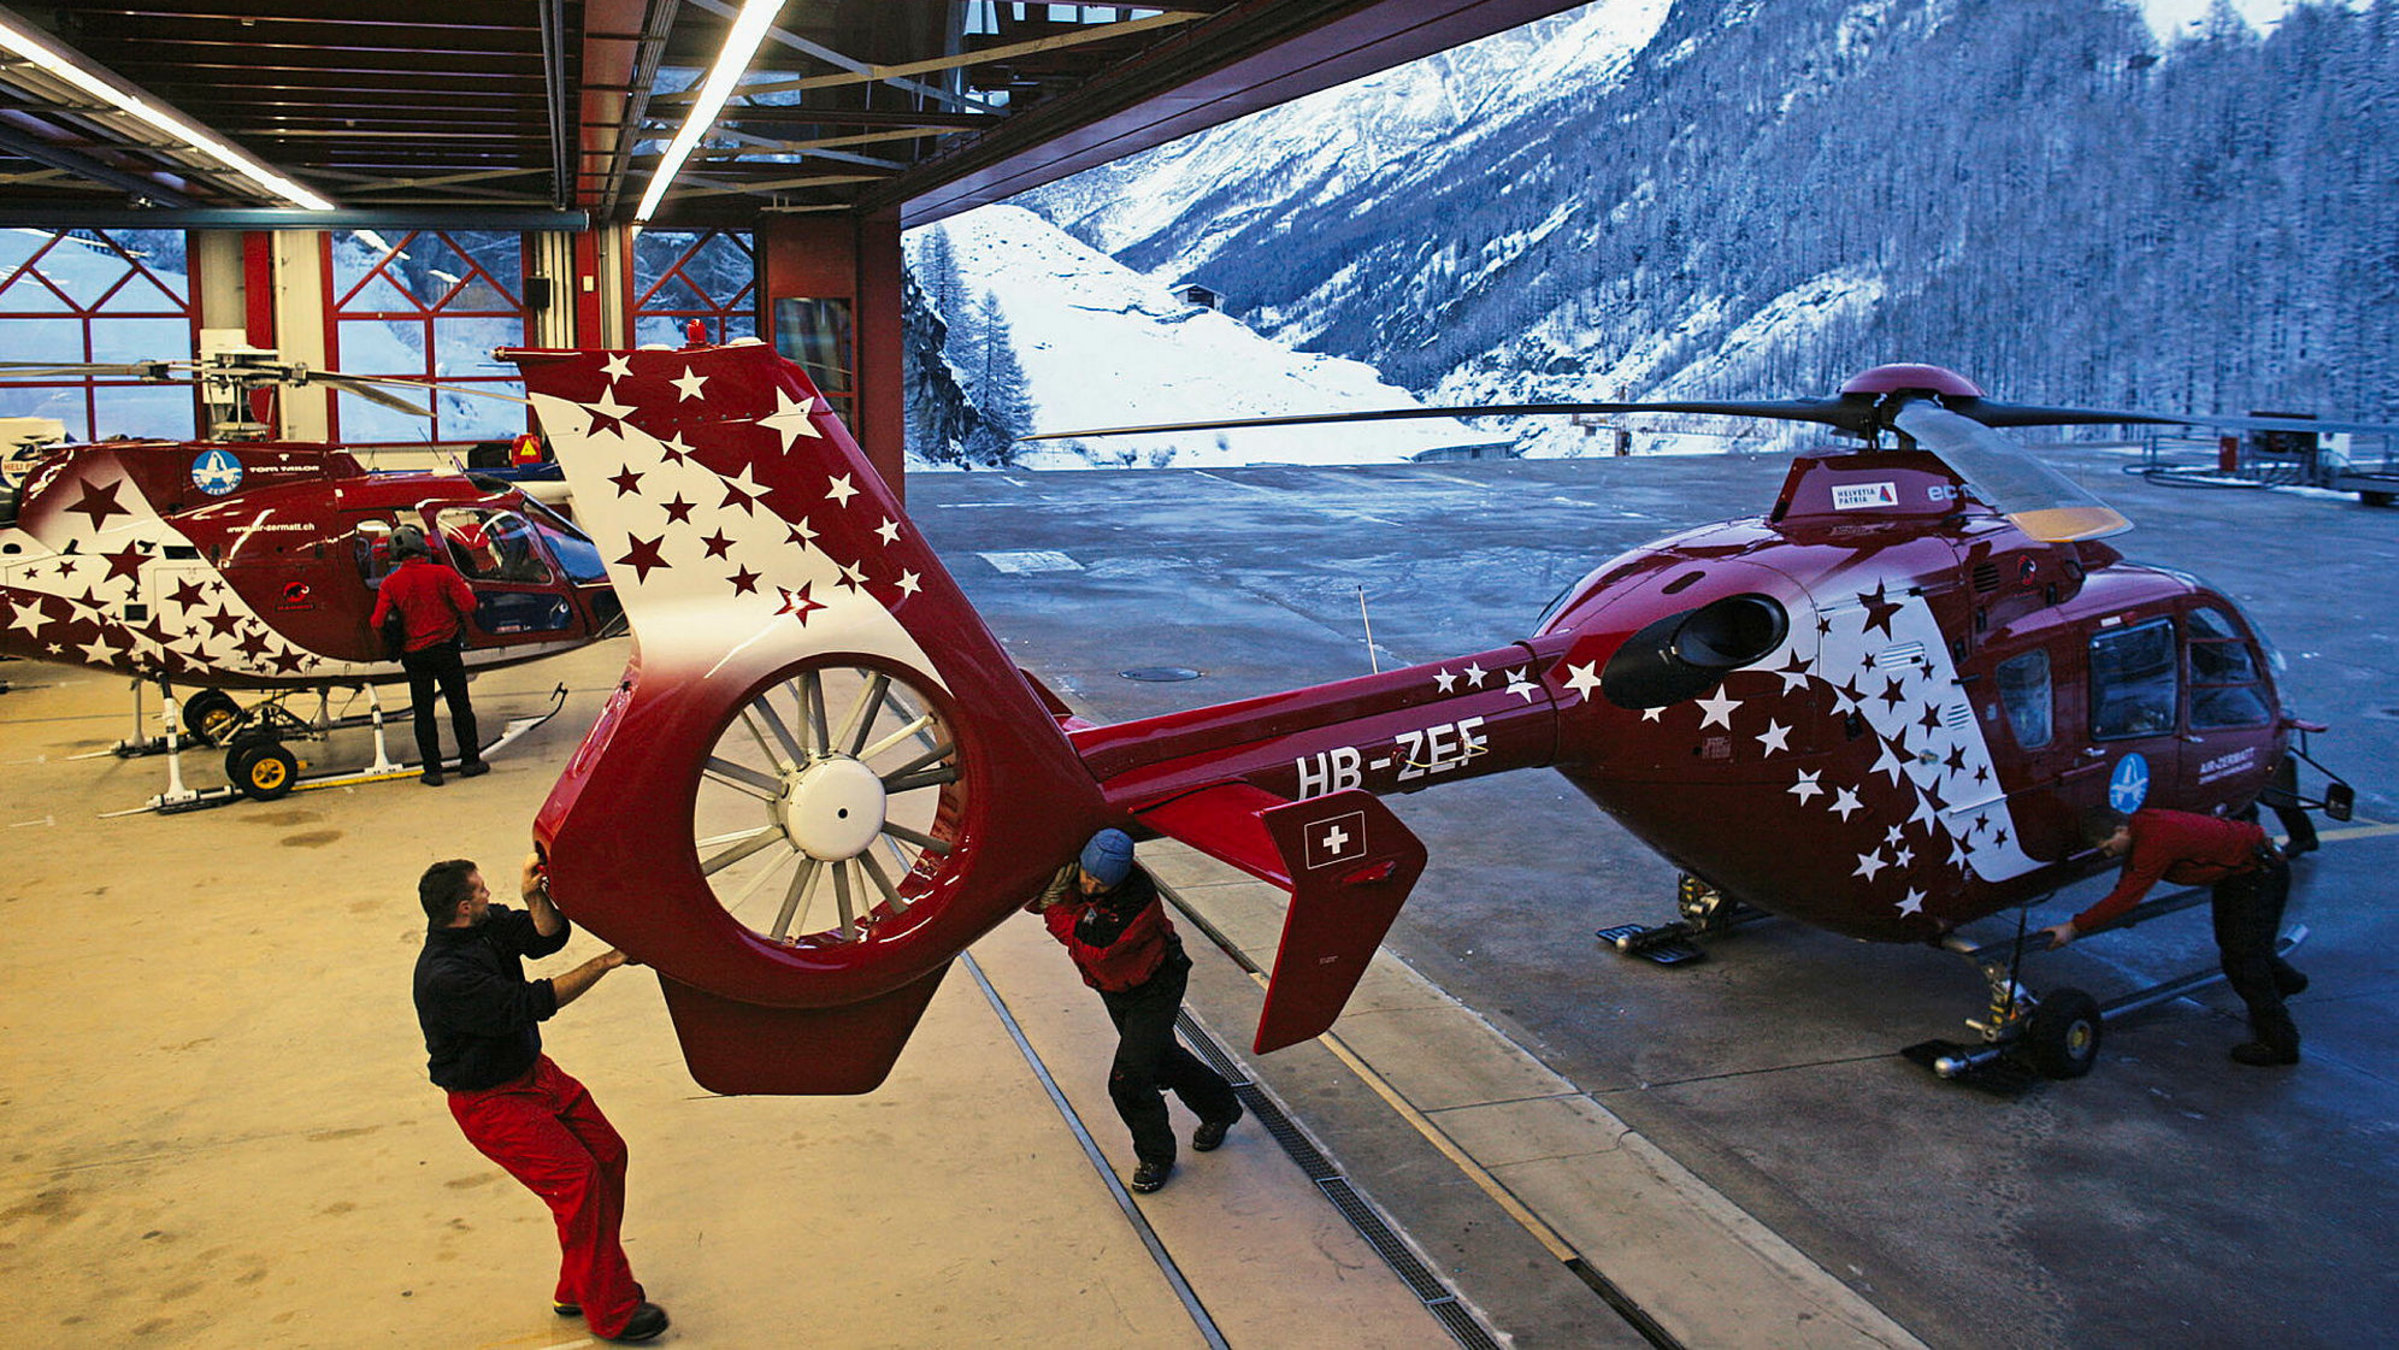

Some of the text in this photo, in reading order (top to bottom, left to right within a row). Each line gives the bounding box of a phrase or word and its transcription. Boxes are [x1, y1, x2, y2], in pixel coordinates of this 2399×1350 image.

[280, 465, 320, 473] TAILOR
[1837, 488, 1876, 497] HELVETIA
[1839, 496, 1868, 505] PATRIA
[1296, 716, 1487, 801] HB-ZEF
